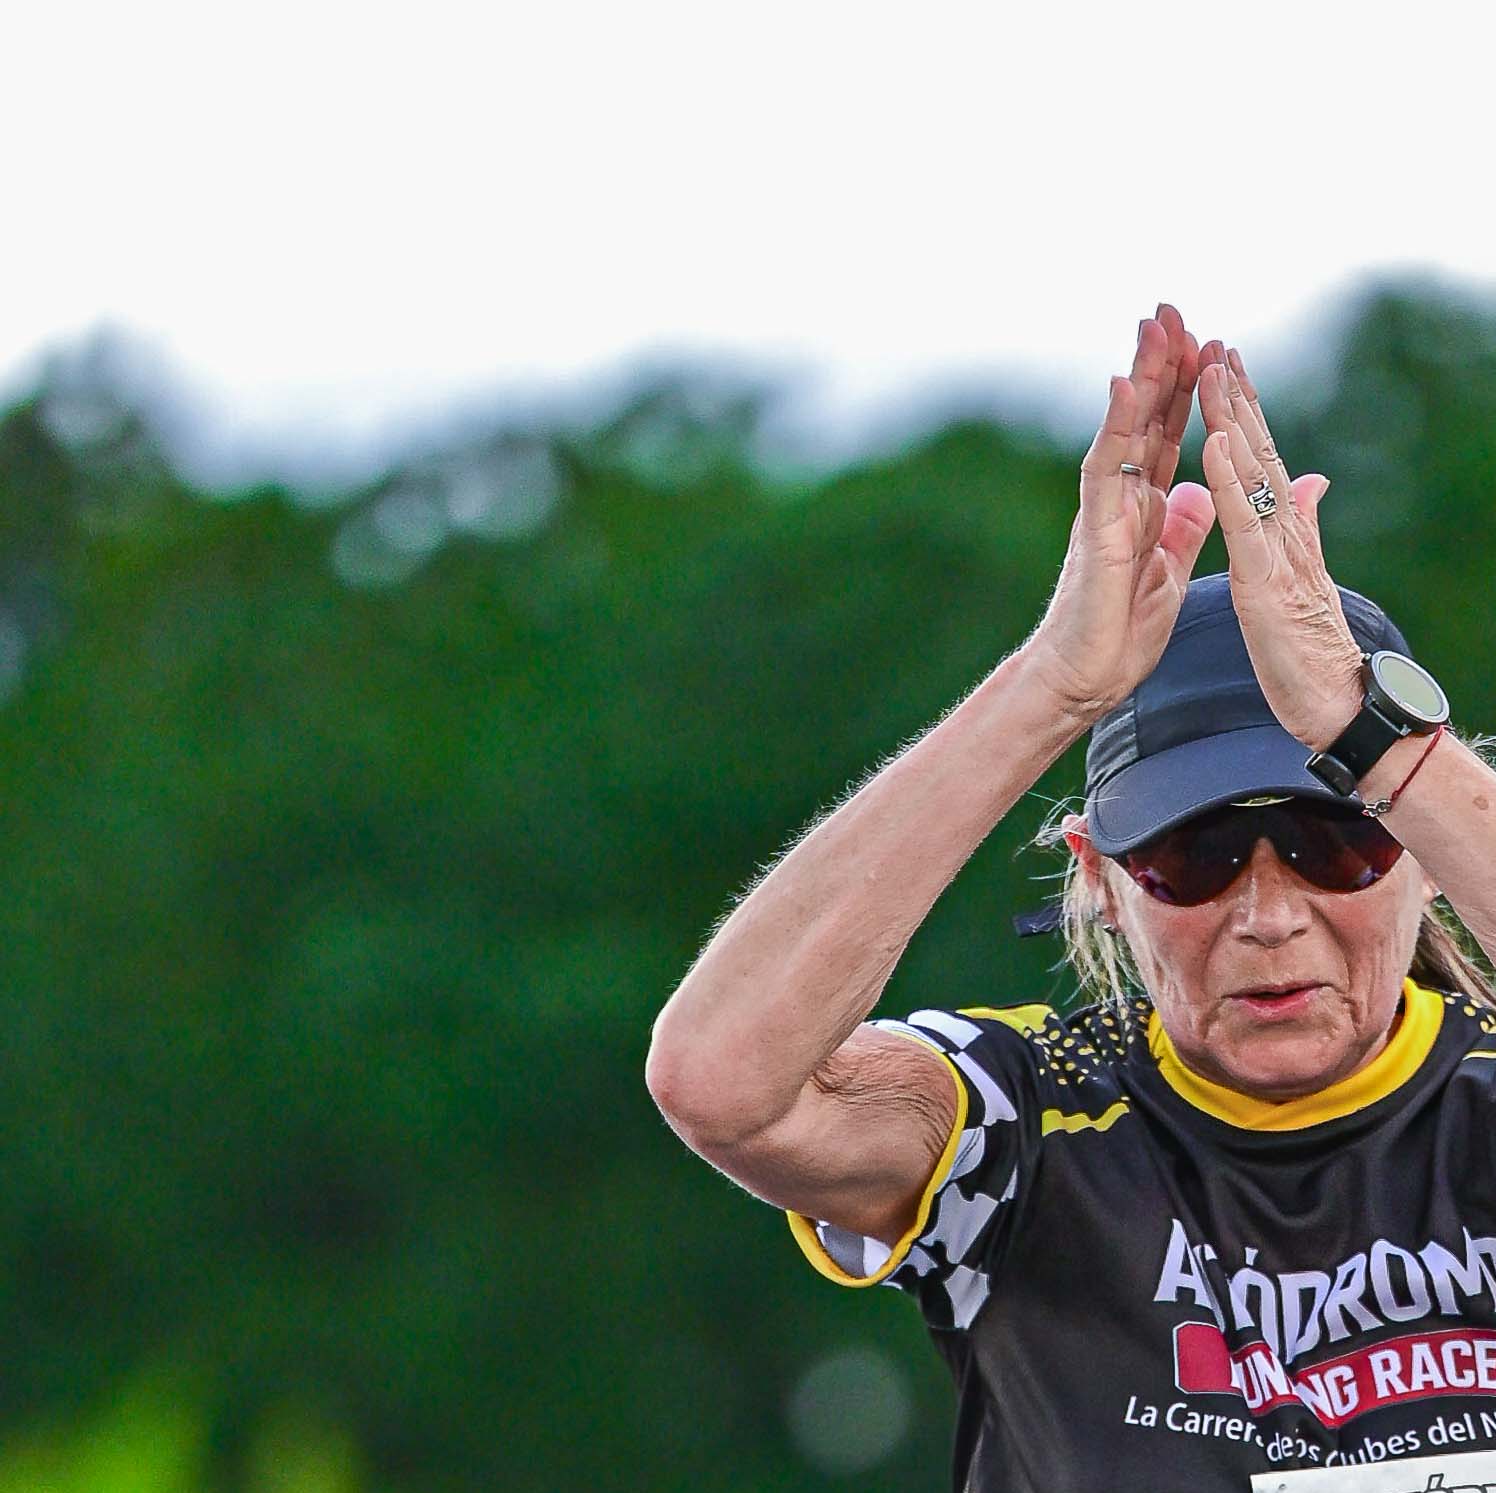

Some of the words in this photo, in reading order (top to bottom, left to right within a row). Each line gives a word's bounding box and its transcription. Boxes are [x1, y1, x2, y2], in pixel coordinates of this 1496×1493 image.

[1124, 1395, 1159, 1428] La
[1165, 1402, 1265, 1447] Carrer
[1267, 1432, 1294, 1462] de
[1427, 1412, 1476, 1446] del
